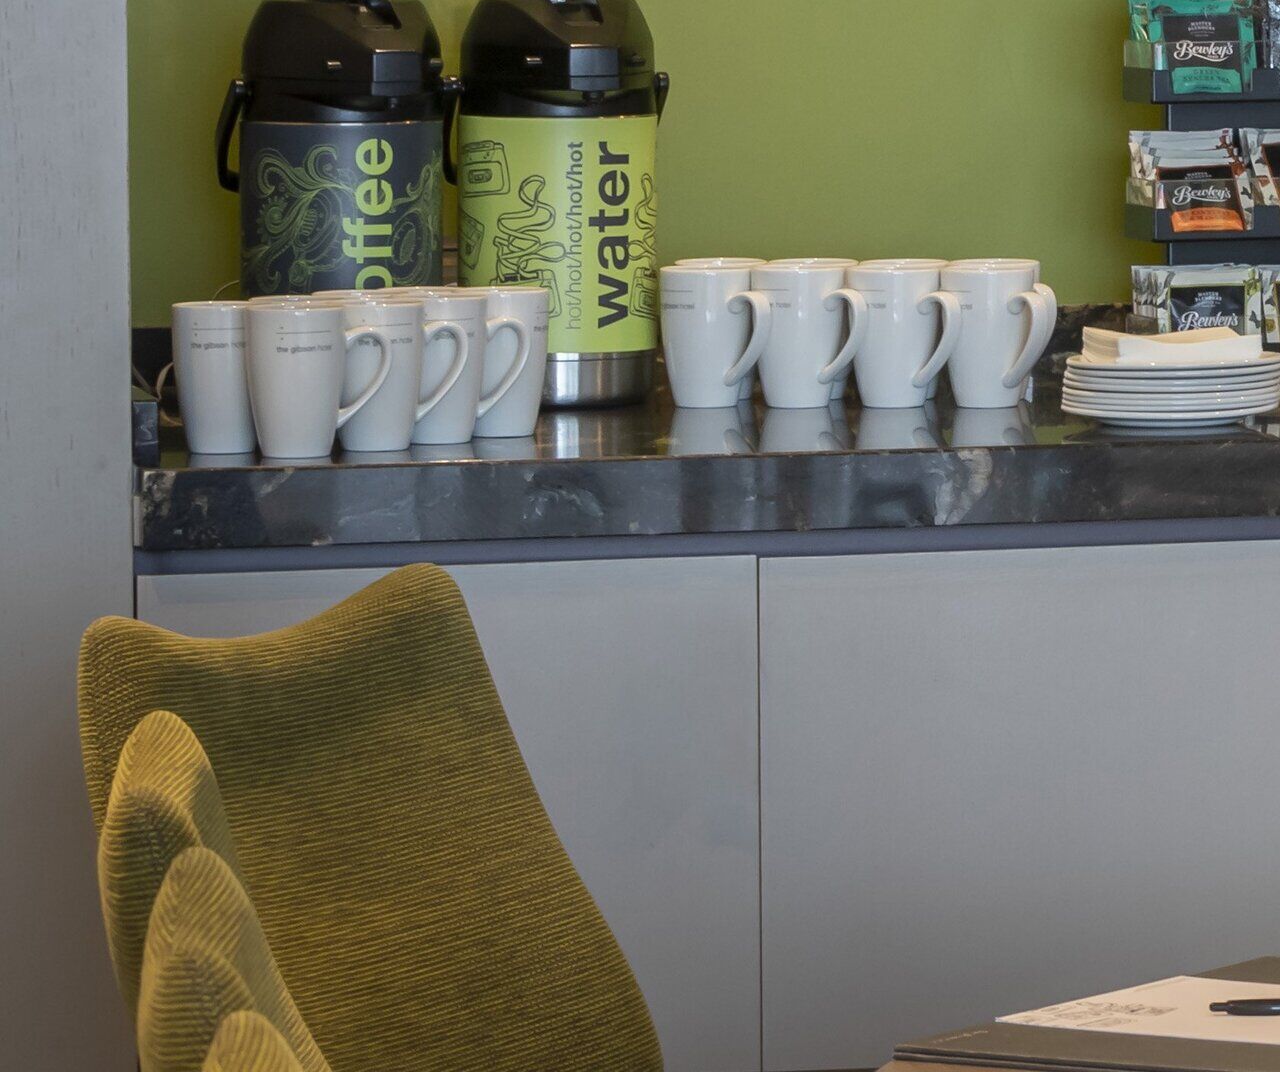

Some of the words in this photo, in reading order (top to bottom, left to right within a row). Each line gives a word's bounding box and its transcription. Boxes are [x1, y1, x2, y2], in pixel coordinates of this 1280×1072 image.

[1173, 39, 1234, 62] Bewley's
[1172, 185, 1232, 205] Bewley's
[342, 138, 394, 290] offee
[588, 140, 630, 329] water
[1177, 310, 1239, 332] Bewley's
